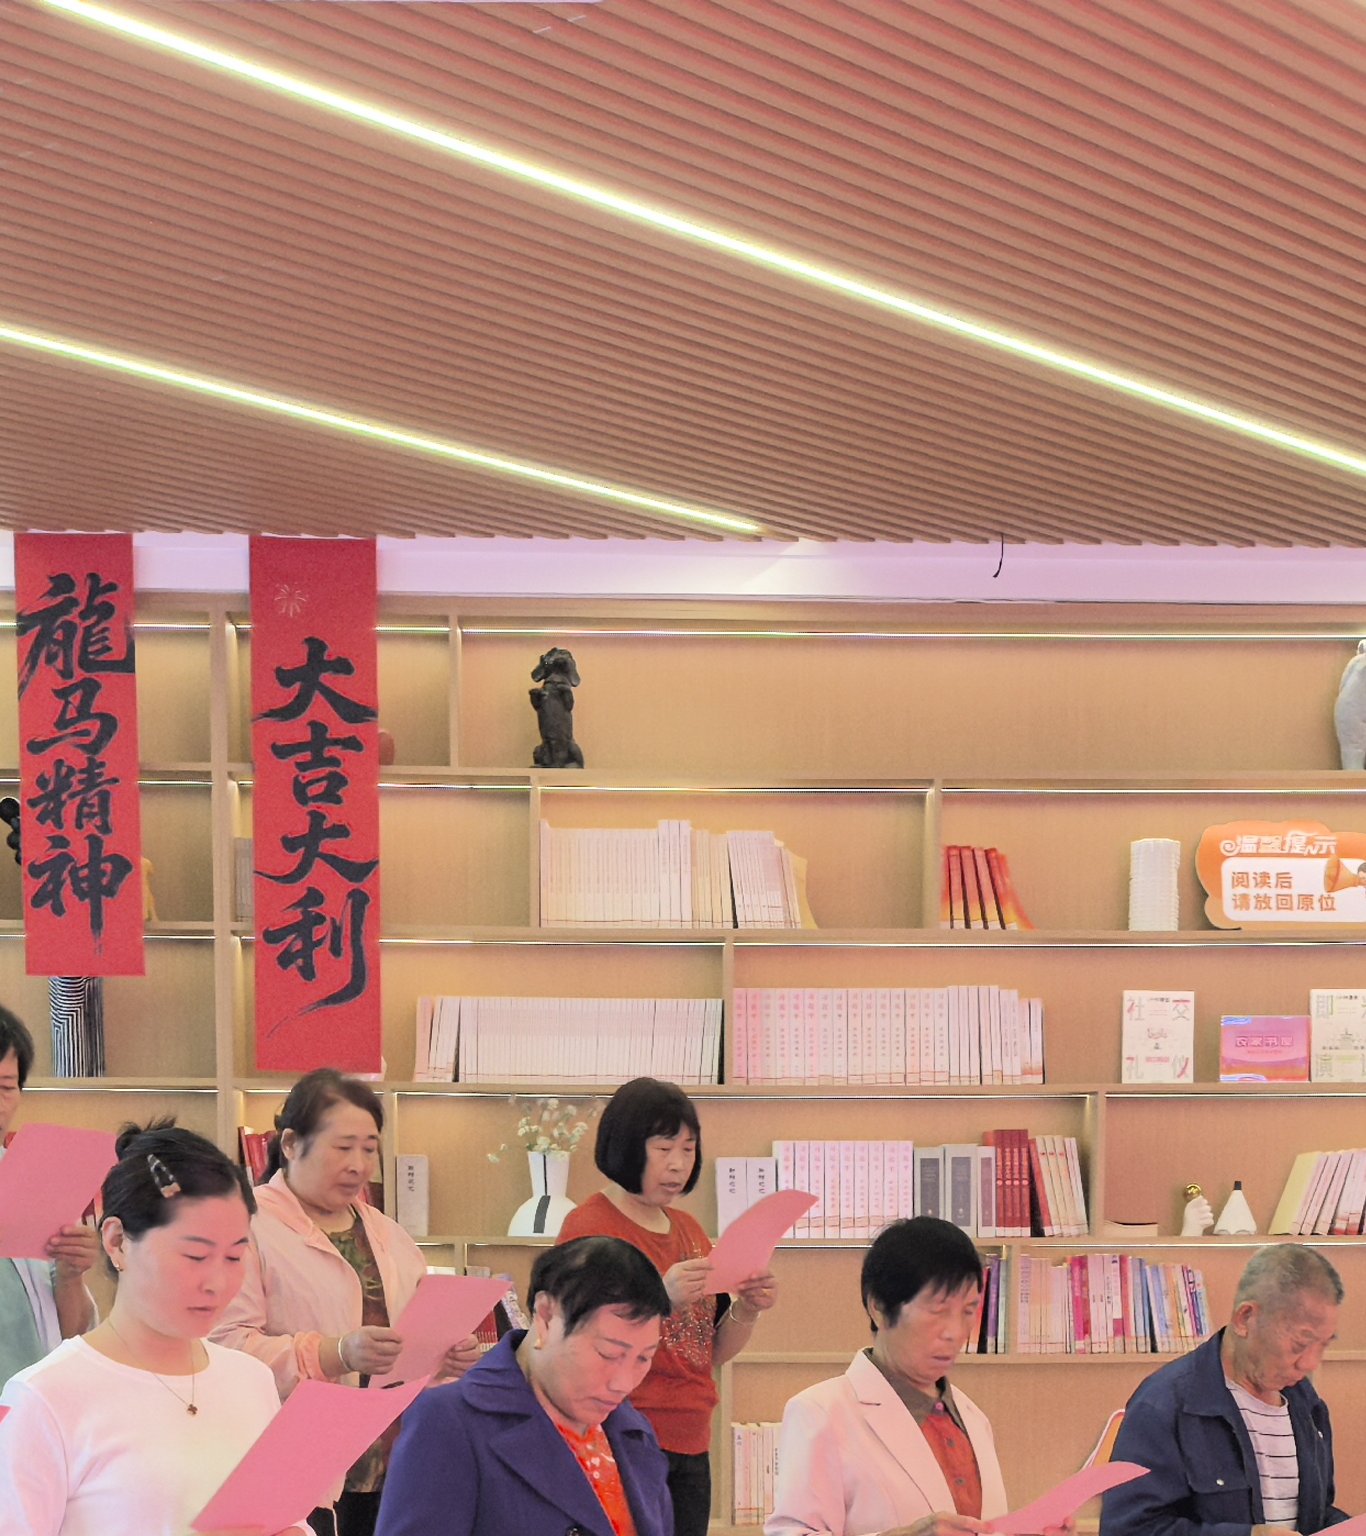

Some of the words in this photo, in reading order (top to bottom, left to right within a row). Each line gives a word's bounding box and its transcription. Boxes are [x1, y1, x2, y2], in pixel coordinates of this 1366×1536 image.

[16, 572, 135, 957] 龍马精神
[252, 636, 379, 1038] 大吉大利
[1219, 829, 1337, 857] 温馨提示
[1231, 871, 1294, 890] 阅读后
[1232, 892, 1337, 912] 请放回原位
